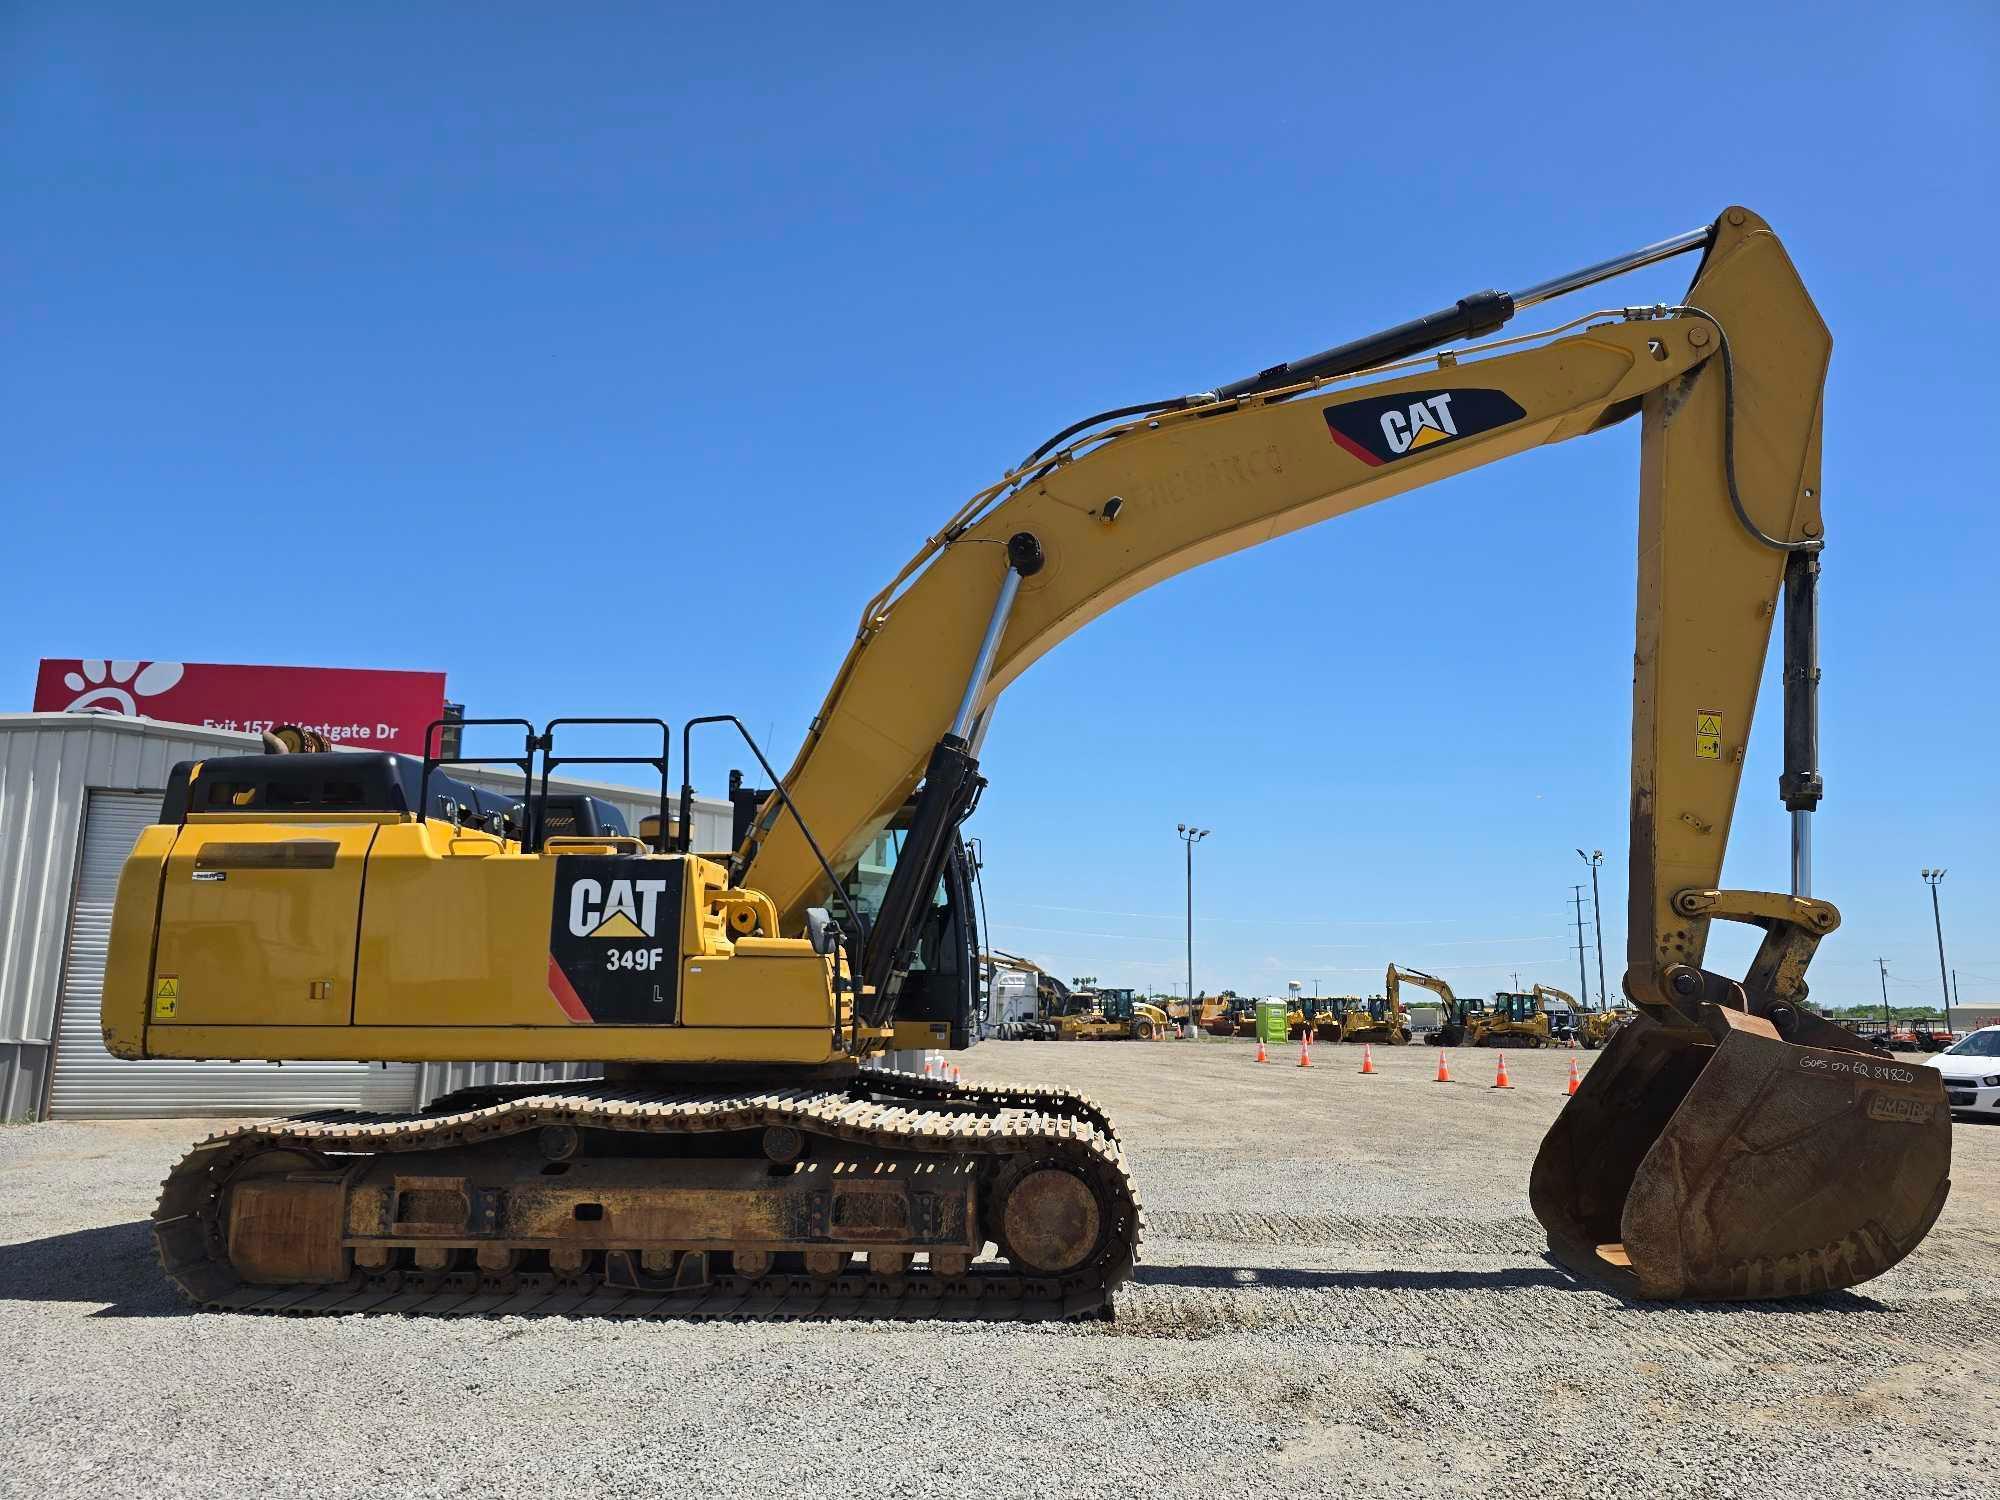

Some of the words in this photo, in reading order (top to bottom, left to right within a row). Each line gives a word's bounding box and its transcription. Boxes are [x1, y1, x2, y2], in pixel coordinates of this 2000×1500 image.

[1380, 393, 1459, 453] CAT
[376, 724, 399, 739] Dr
[569, 878, 667, 937] CAT
[606, 947, 663, 971] 349F
[653, 984, 663, 1002] L
[1853, 1061, 1872, 1078] EQ
